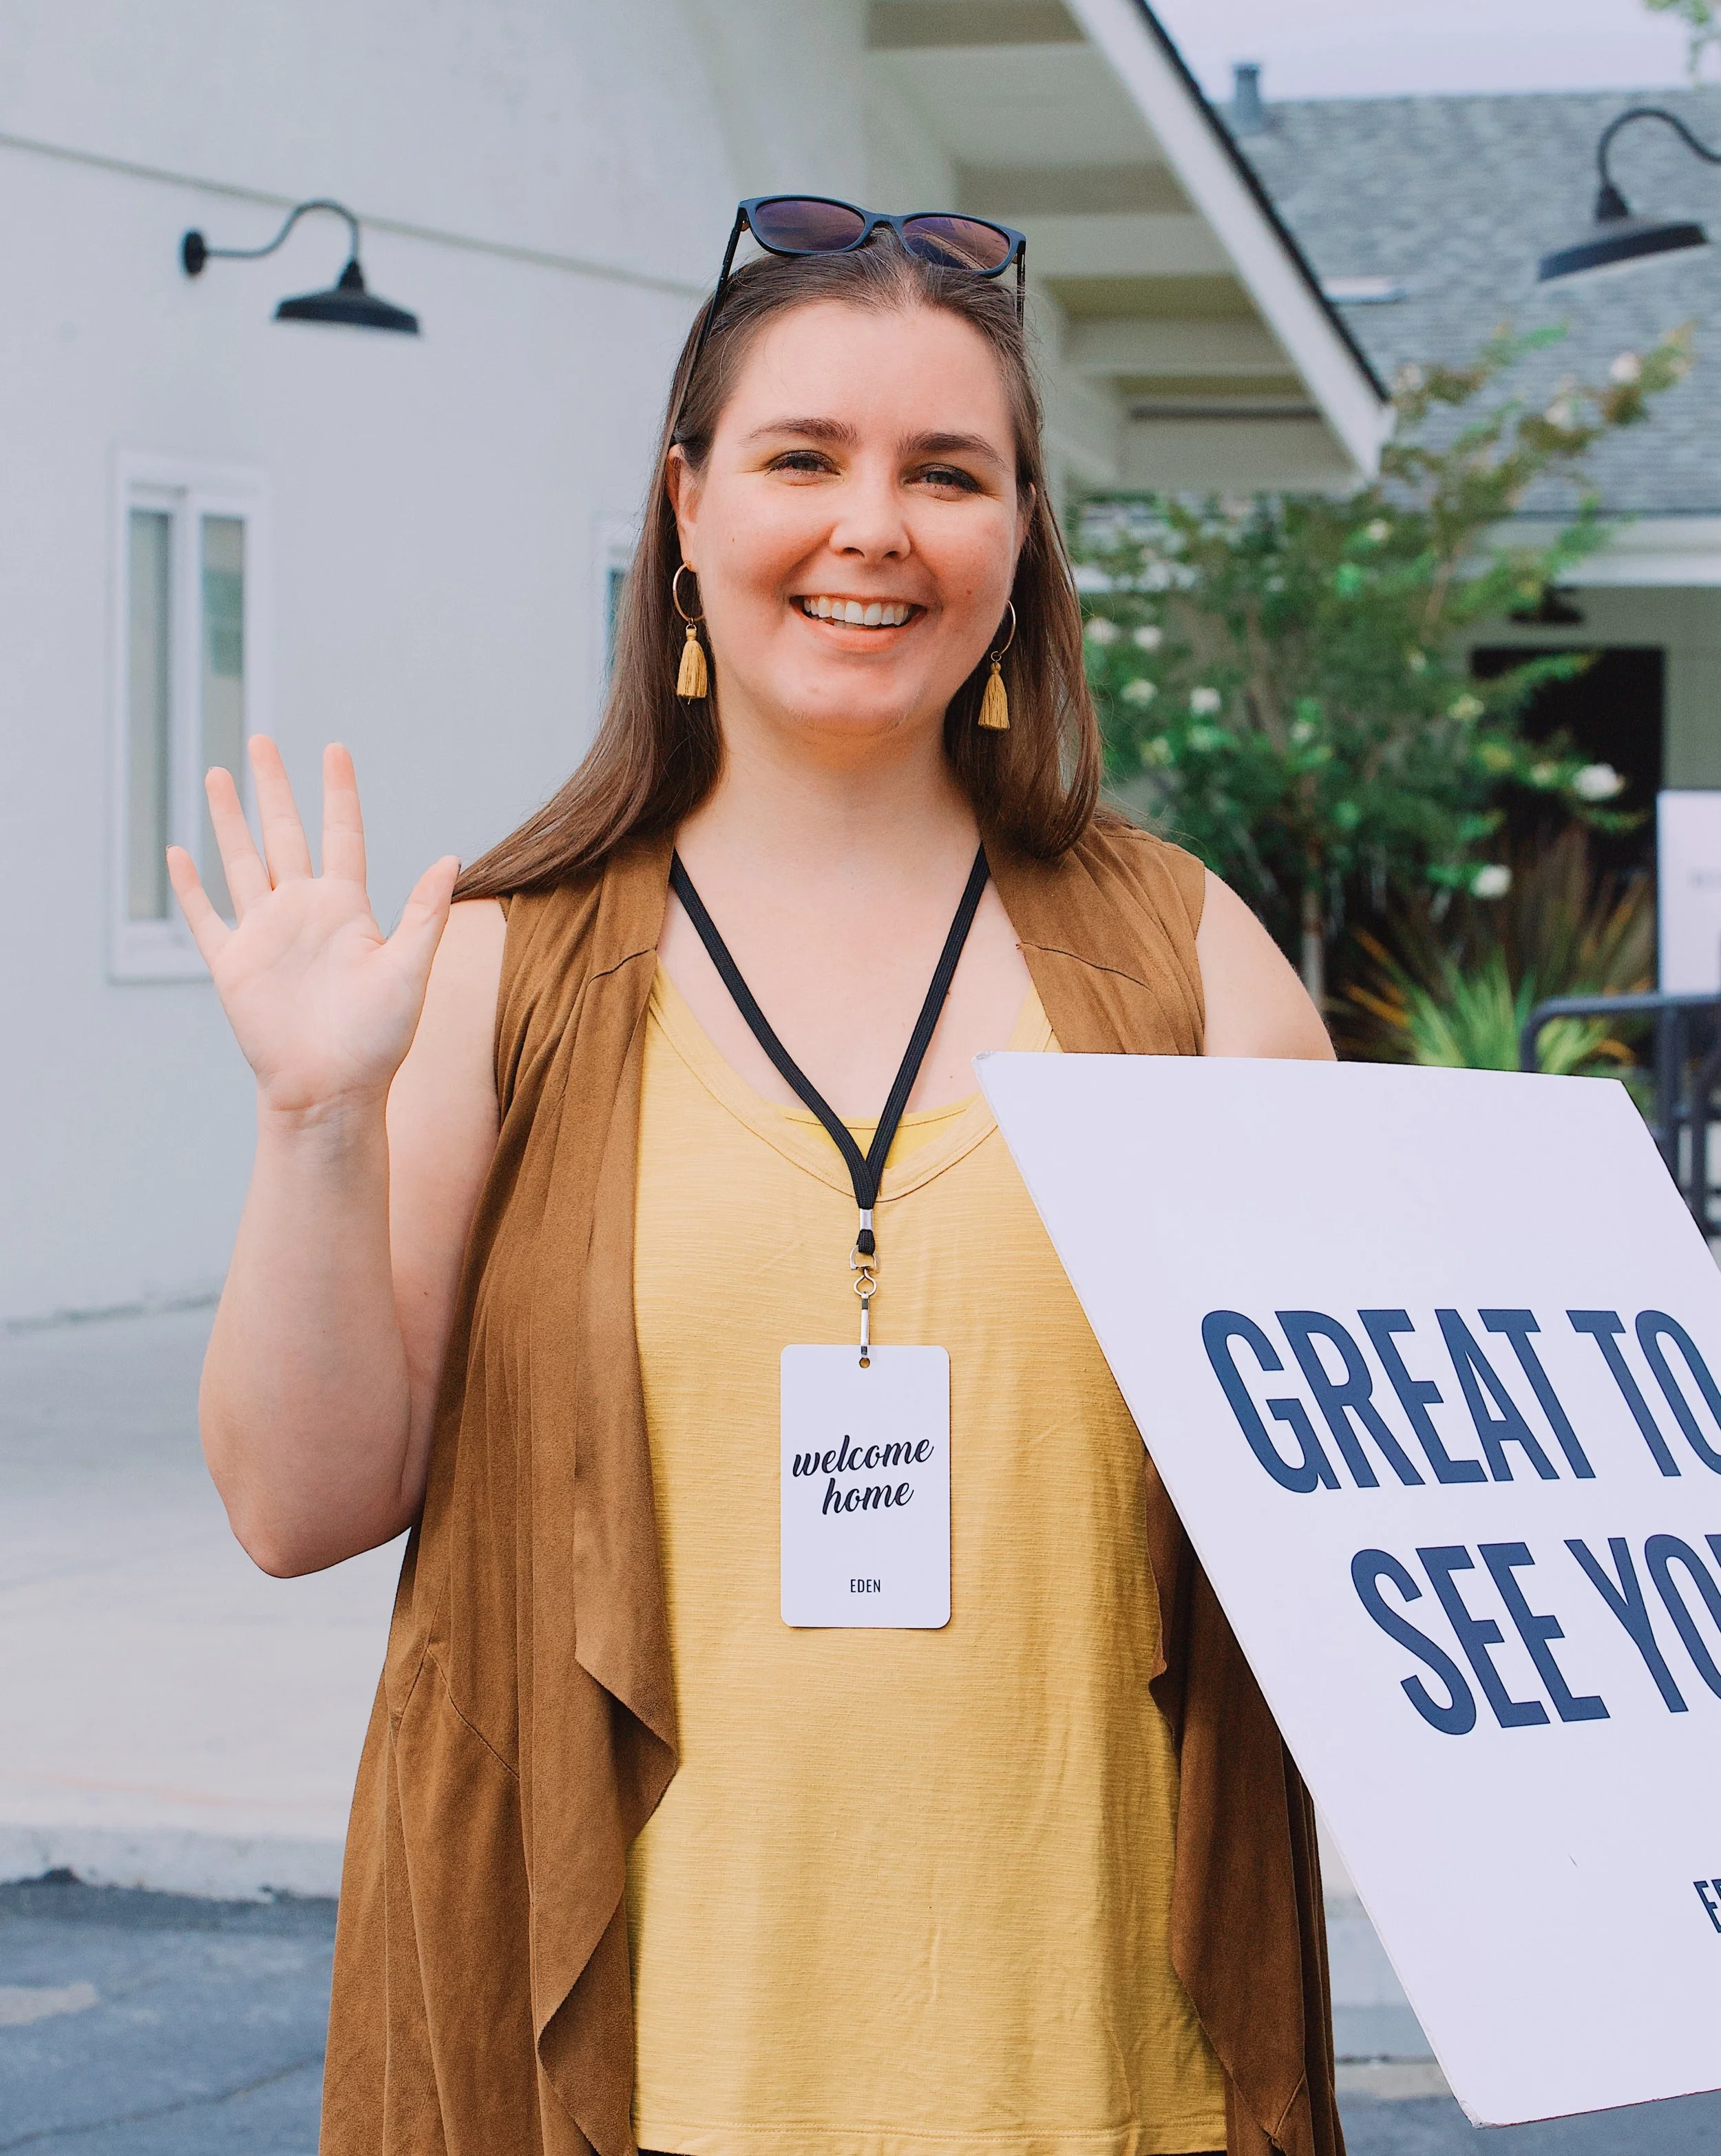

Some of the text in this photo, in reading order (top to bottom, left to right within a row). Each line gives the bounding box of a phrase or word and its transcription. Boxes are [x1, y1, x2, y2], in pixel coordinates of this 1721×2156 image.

[1201, 1309, 1721, 1494] GREAT TO
[792, 1435, 935, 1478] welcome
[822, 1477, 915, 1515] home
[850, 1578, 881, 1593] EDEN
[1350, 1534, 1721, 1735] SEE YO
